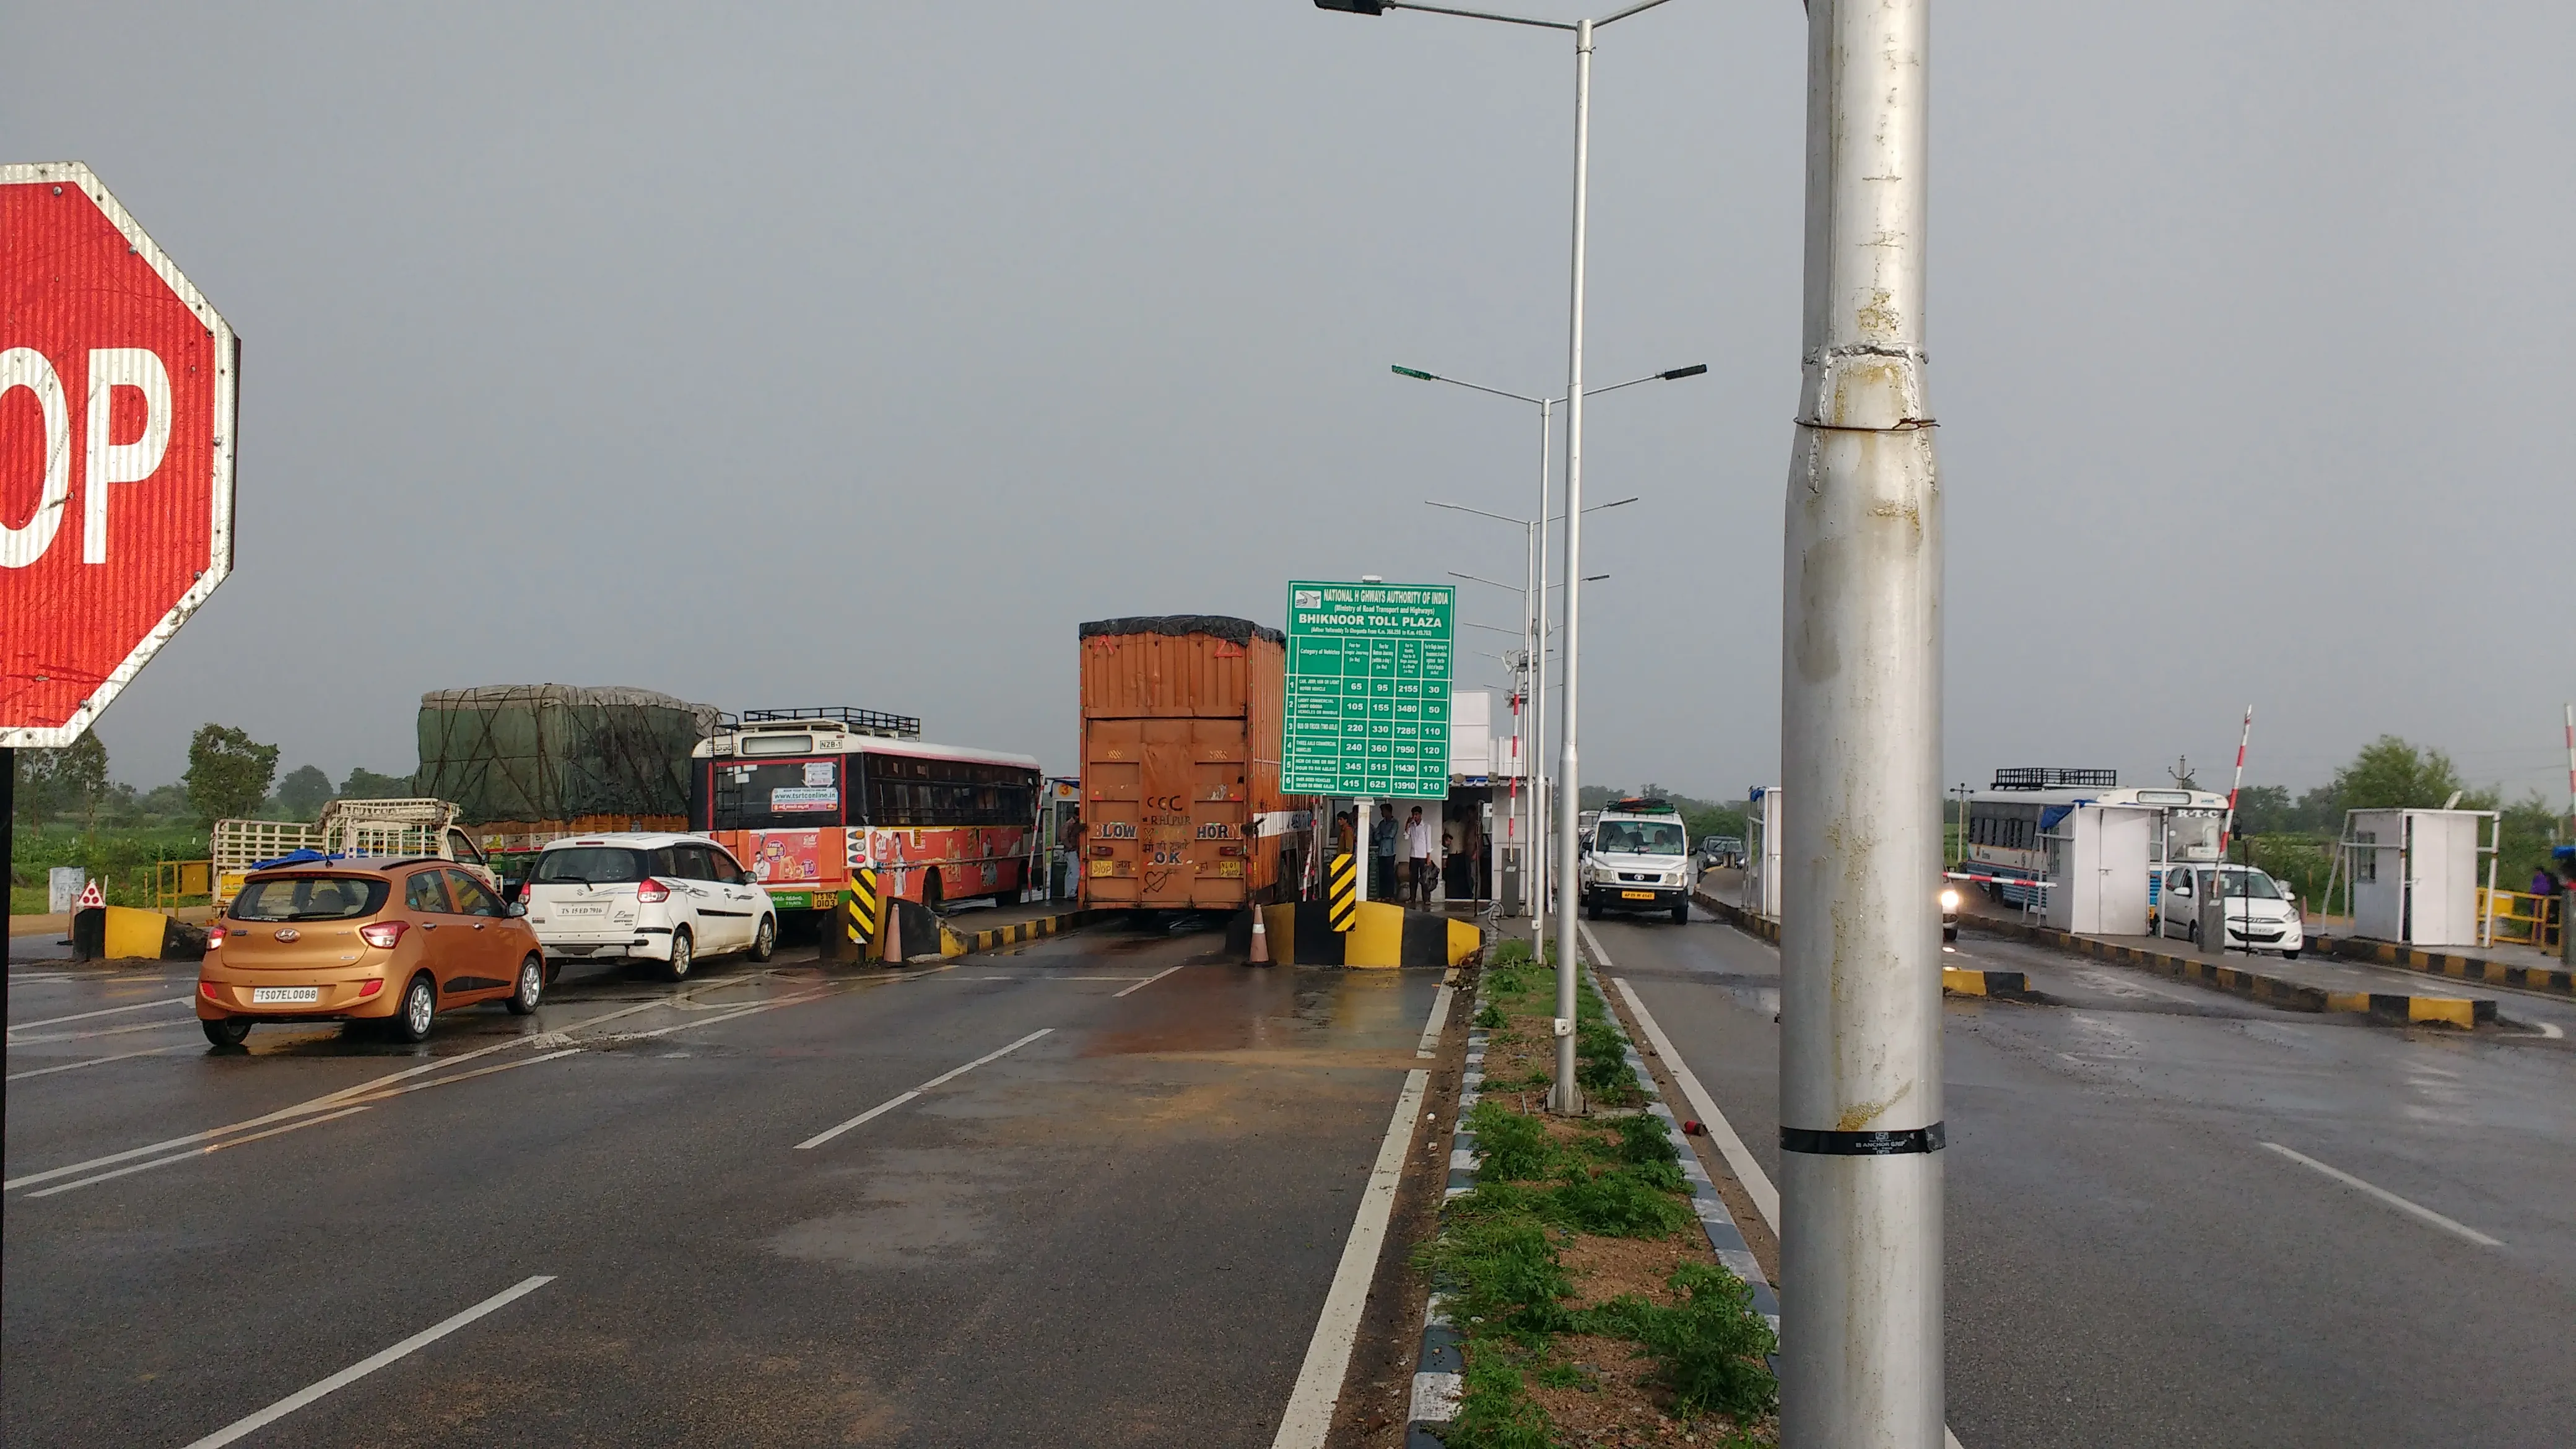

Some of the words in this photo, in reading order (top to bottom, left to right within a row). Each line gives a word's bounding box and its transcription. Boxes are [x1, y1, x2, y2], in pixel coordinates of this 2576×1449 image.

[1324, 589, 1353, 602] NATIONAL
[1386, 591, 1422, 604] AUTHORITY
[1422, 591, 1430, 604] OF
[1432, 592, 1448, 604] INDIA
[1376, 606, 1399, 614] Transport
[1410, 607, 1435, 616] Highways)
[1299, 614, 1364, 625] BHIKNOOR
[1368, 616, 1398, 626] TOLL
[1403, 617, 1442, 627] PLAZA
[1061, 784, 1069, 795] 3
[1095, 824, 1138, 838] BLOW
[1196, 824, 1243, 839] HORN
[1154, 852, 1182, 865] OK
[261, 990, 316, 1000] TS07EL0088
